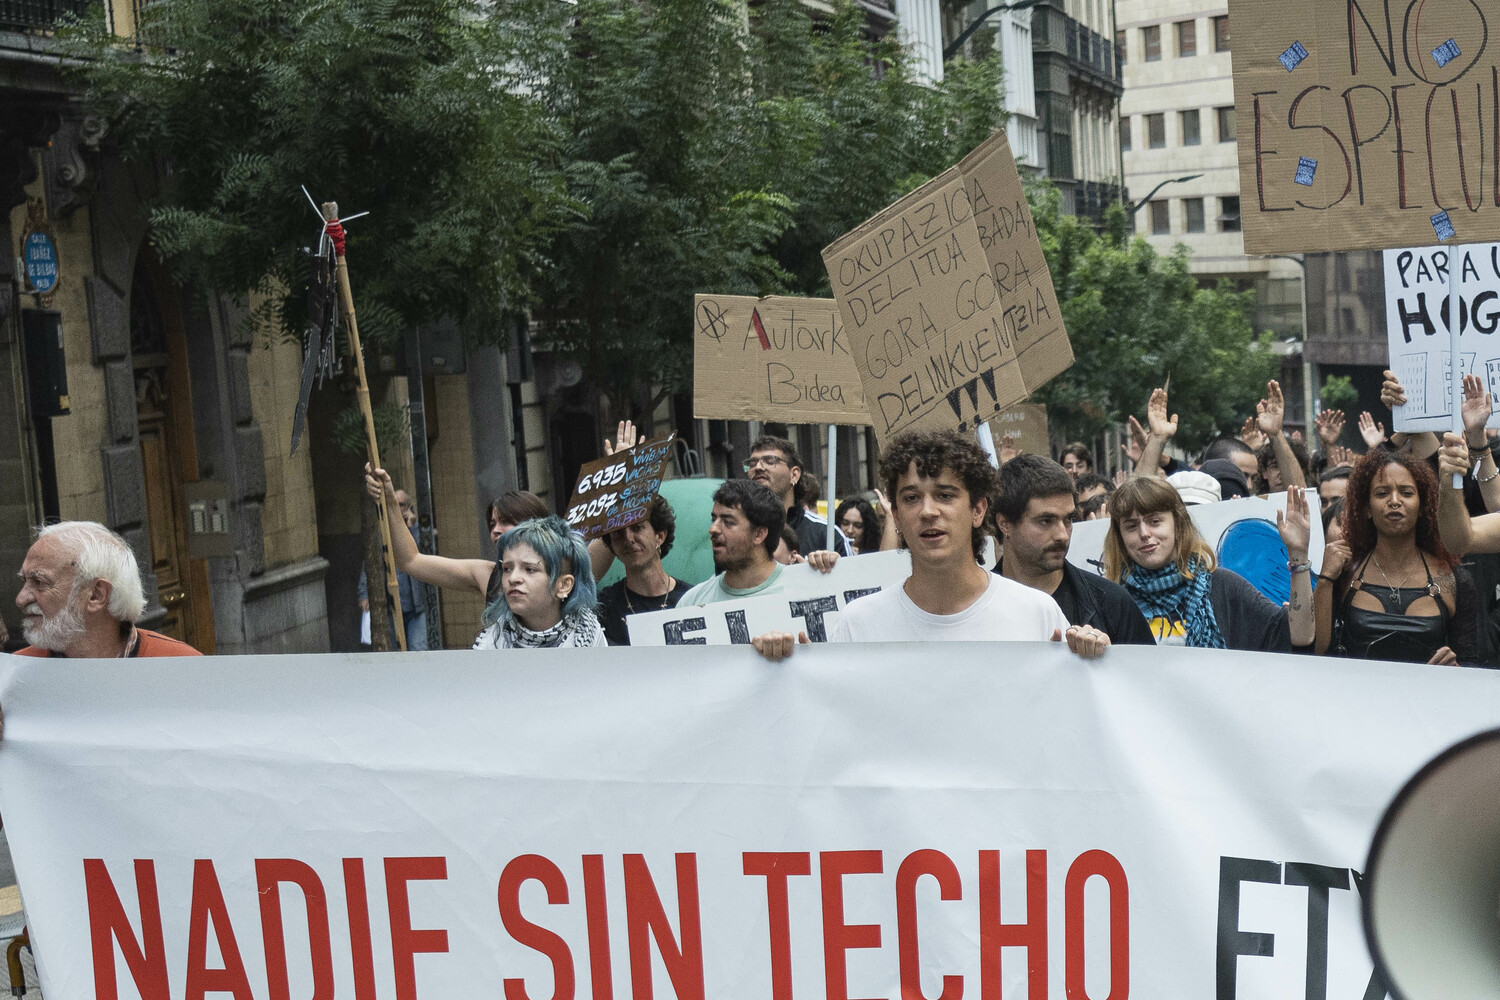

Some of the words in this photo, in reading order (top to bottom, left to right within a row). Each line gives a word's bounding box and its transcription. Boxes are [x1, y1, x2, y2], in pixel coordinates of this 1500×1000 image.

[1347, 0, 1488, 84] NO
[839, 178, 989, 287] OKUPAZIOA
[848, 233, 966, 328] DELITUA
[978, 201, 1030, 249] BADA,
[1396, 250, 1480, 288] PARA
[955, 250, 1032, 321] GORA
[767, 362, 845, 405] Bidea
[877, 287, 1051, 434] DELINKUENTZIA
[578, 461, 627, 495] 6.935
